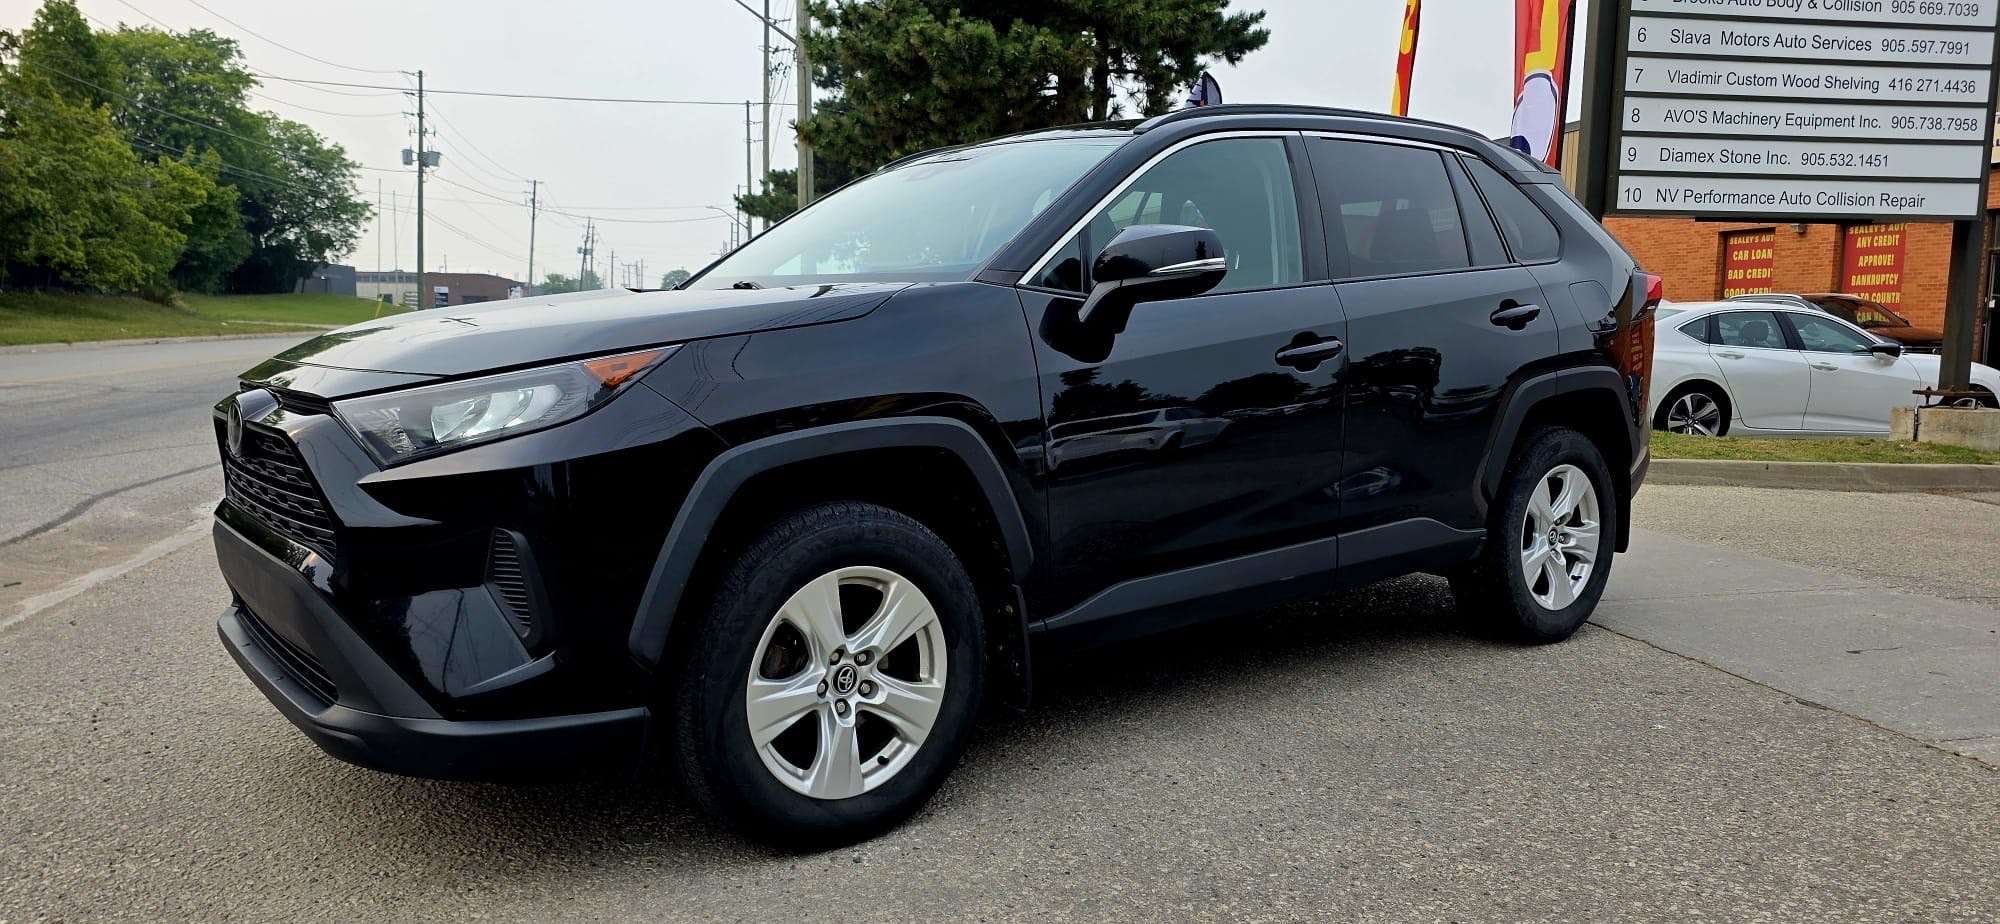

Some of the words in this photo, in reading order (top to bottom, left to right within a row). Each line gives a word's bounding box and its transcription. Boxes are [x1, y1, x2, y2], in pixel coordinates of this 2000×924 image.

[1891, 0, 1916, 13] 905
[1919, 2, 1979, 16] 669.7039
[1637, 27, 1647, 42] 6
[1670, 29, 1711, 44] Slava
[1720, 31, 1770, 47] Motors
[1773, 34, 1807, 48] Auto
[1811, 35, 1872, 51] Services
[1634, 69, 1644, 83] 7
[1667, 70, 1723, 84] Vladimir
[1726, 72, 1778, 86] Custom
[1782, 74, 1821, 88] Wood
[1824, 76, 1880, 93] Shelving
[1888, 79, 1913, 91] 416
[1916, 79, 1976, 93] 271.4436
[1631, 108, 1641, 122] 8
[1663, 110, 1708, 123] AVO'S
[1712, 111, 1782, 128] Machinery
[1785, 113, 1855, 130] Equipment
[1859, 115, 1881, 128] Inc.
[1891, 116, 1978, 131] 905.738.7958
[1627, 147, 1637, 161] 9
[1659, 148, 1716, 163] Diamex
[1719, 149, 1762, 164] Stone
[1766, 150, 1791, 164] Inc.
[1800, 153, 1889, 167] 905.532.1451
[1624, 188, 1642, 202] 10
[1656, 189, 1680, 202] NV
[1683, 189, 1776, 204] Performance
[1778, 191, 1812, 205] Auto
[1816, 192, 1875, 206] Collision
[1879, 193, 1926, 210] Repair
[1761, 234, 1775, 243] AUT
[1856, 236, 1872, 248] ANY
[1873, 234, 1900, 247] CREDIT
[1733, 250, 1749, 261] CAR
[1751, 247, 1773, 260] LOAN
[1858, 254, 1894, 267] APPROVE!
[1728, 269, 1744, 280] BAD
[1851, 273, 1899, 287] BANKRUPTCY
